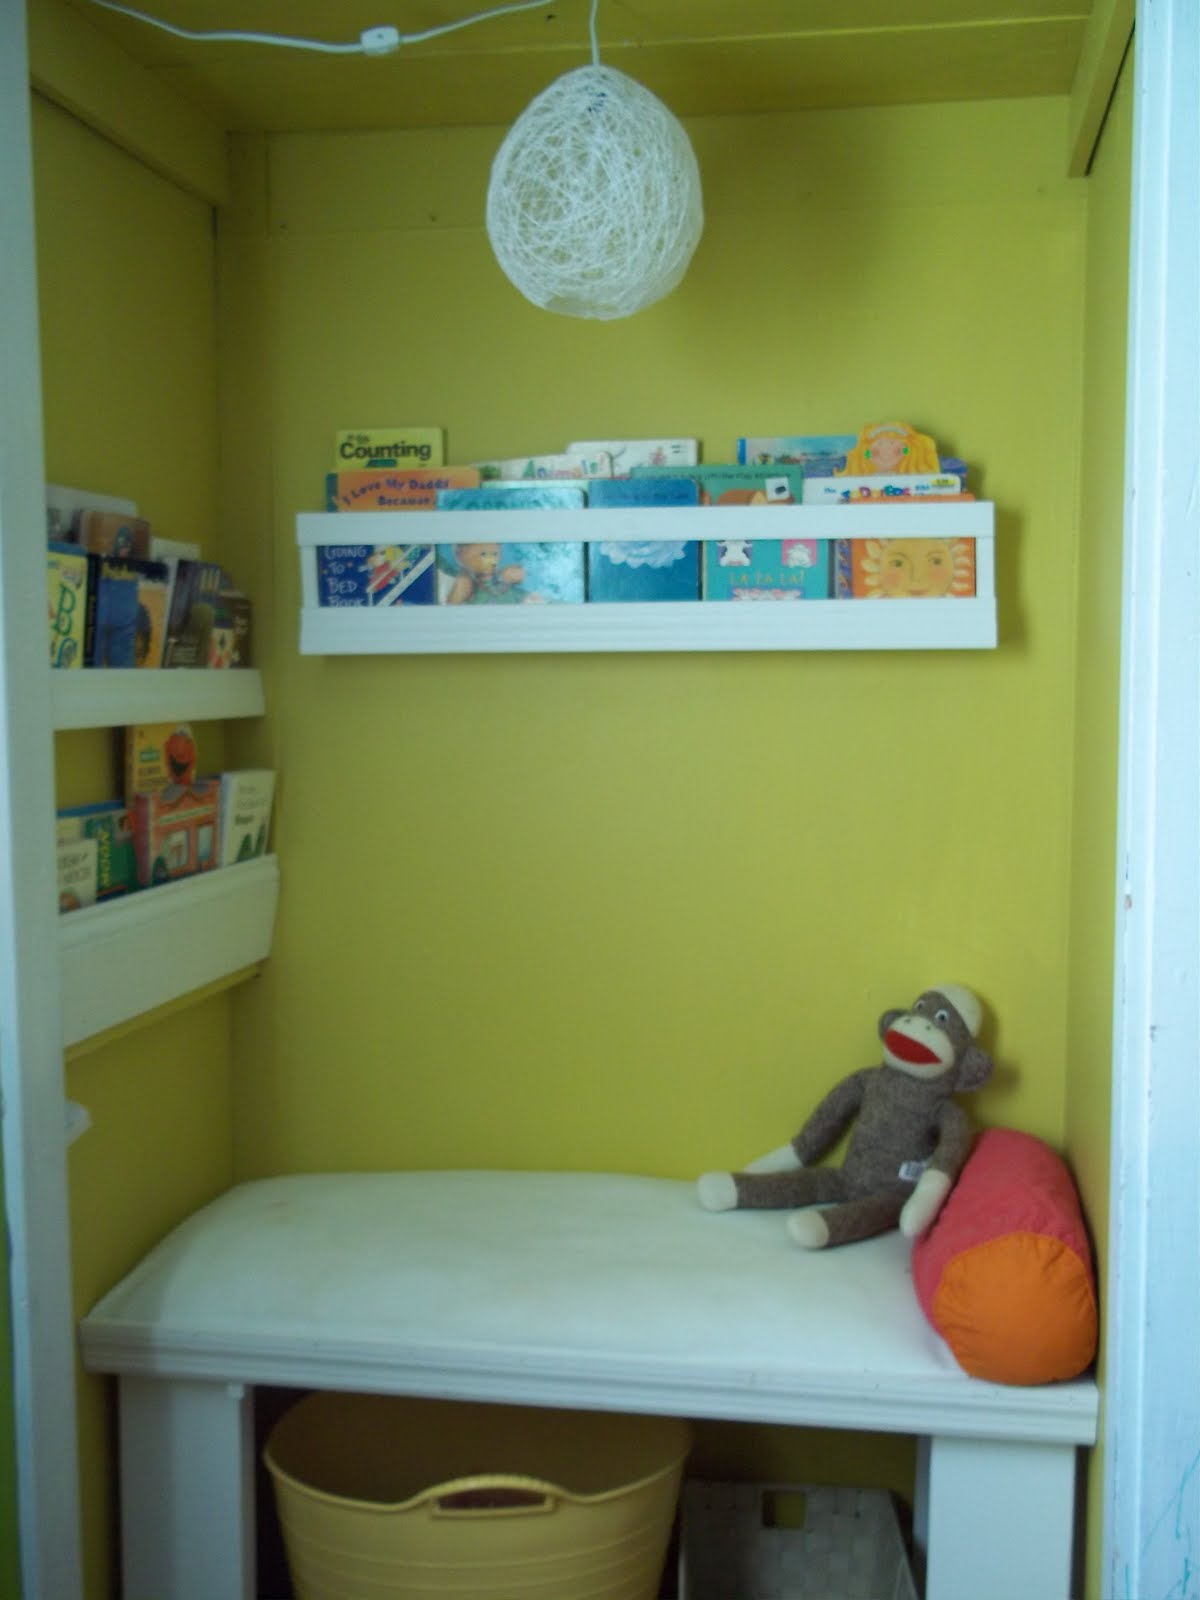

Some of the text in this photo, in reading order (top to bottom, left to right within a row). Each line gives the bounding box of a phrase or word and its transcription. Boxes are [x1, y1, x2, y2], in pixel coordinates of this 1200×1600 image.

[340, 440, 432, 461] Counting
[351, 481, 381, 499] Love
[325, 545, 367, 561] GOING
[327, 577, 359, 595] BED
